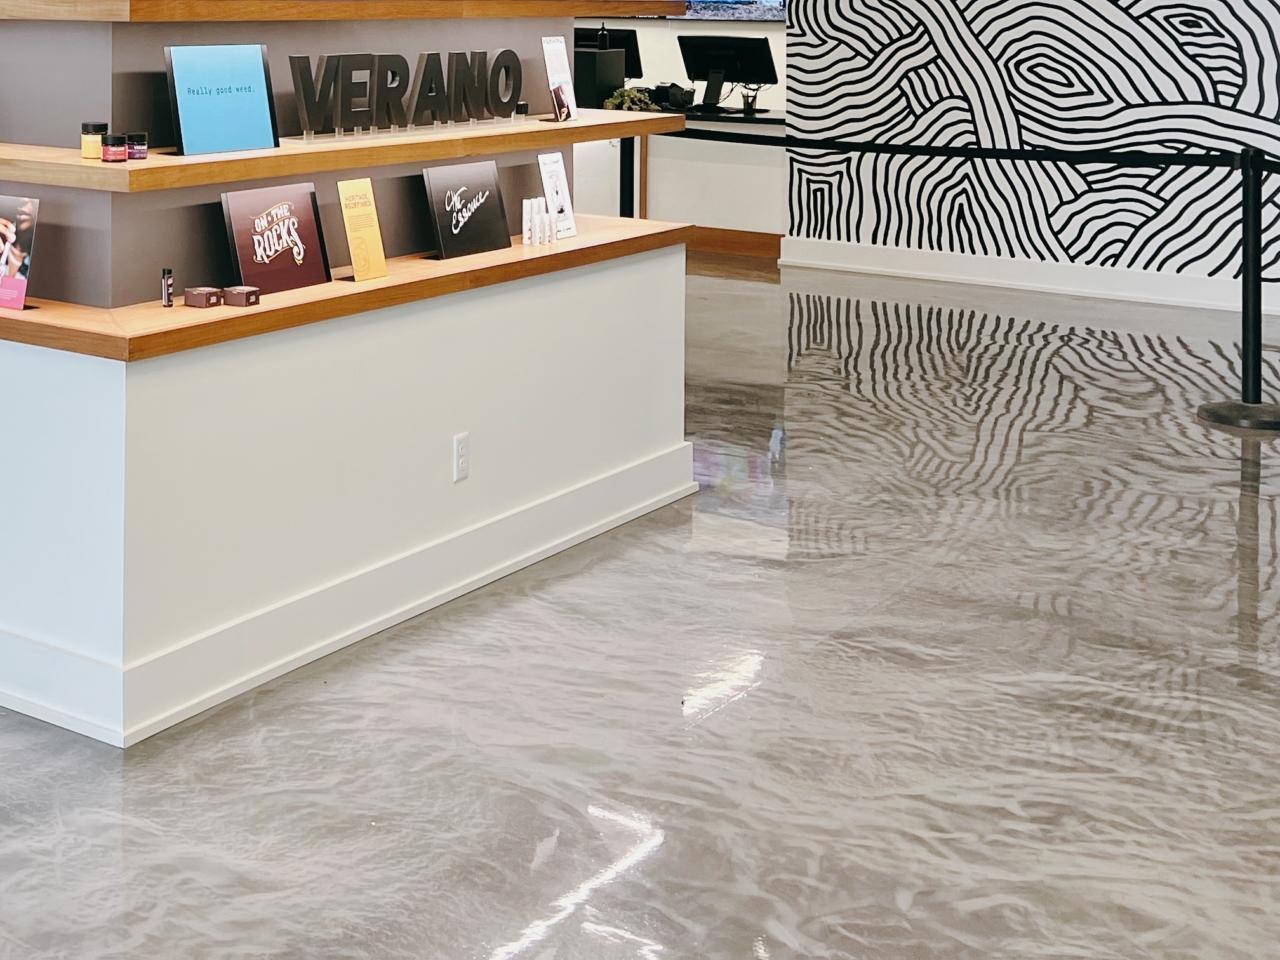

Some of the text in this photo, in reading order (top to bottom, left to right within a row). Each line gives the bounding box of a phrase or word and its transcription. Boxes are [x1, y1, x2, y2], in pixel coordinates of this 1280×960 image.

[187, 87, 212, 96] Really
[216, 86, 233, 96] good
[289, 48, 522, 132] VERANO
[254, 204, 290, 232] ON THE
[252, 217, 305, 264] ROCKS
